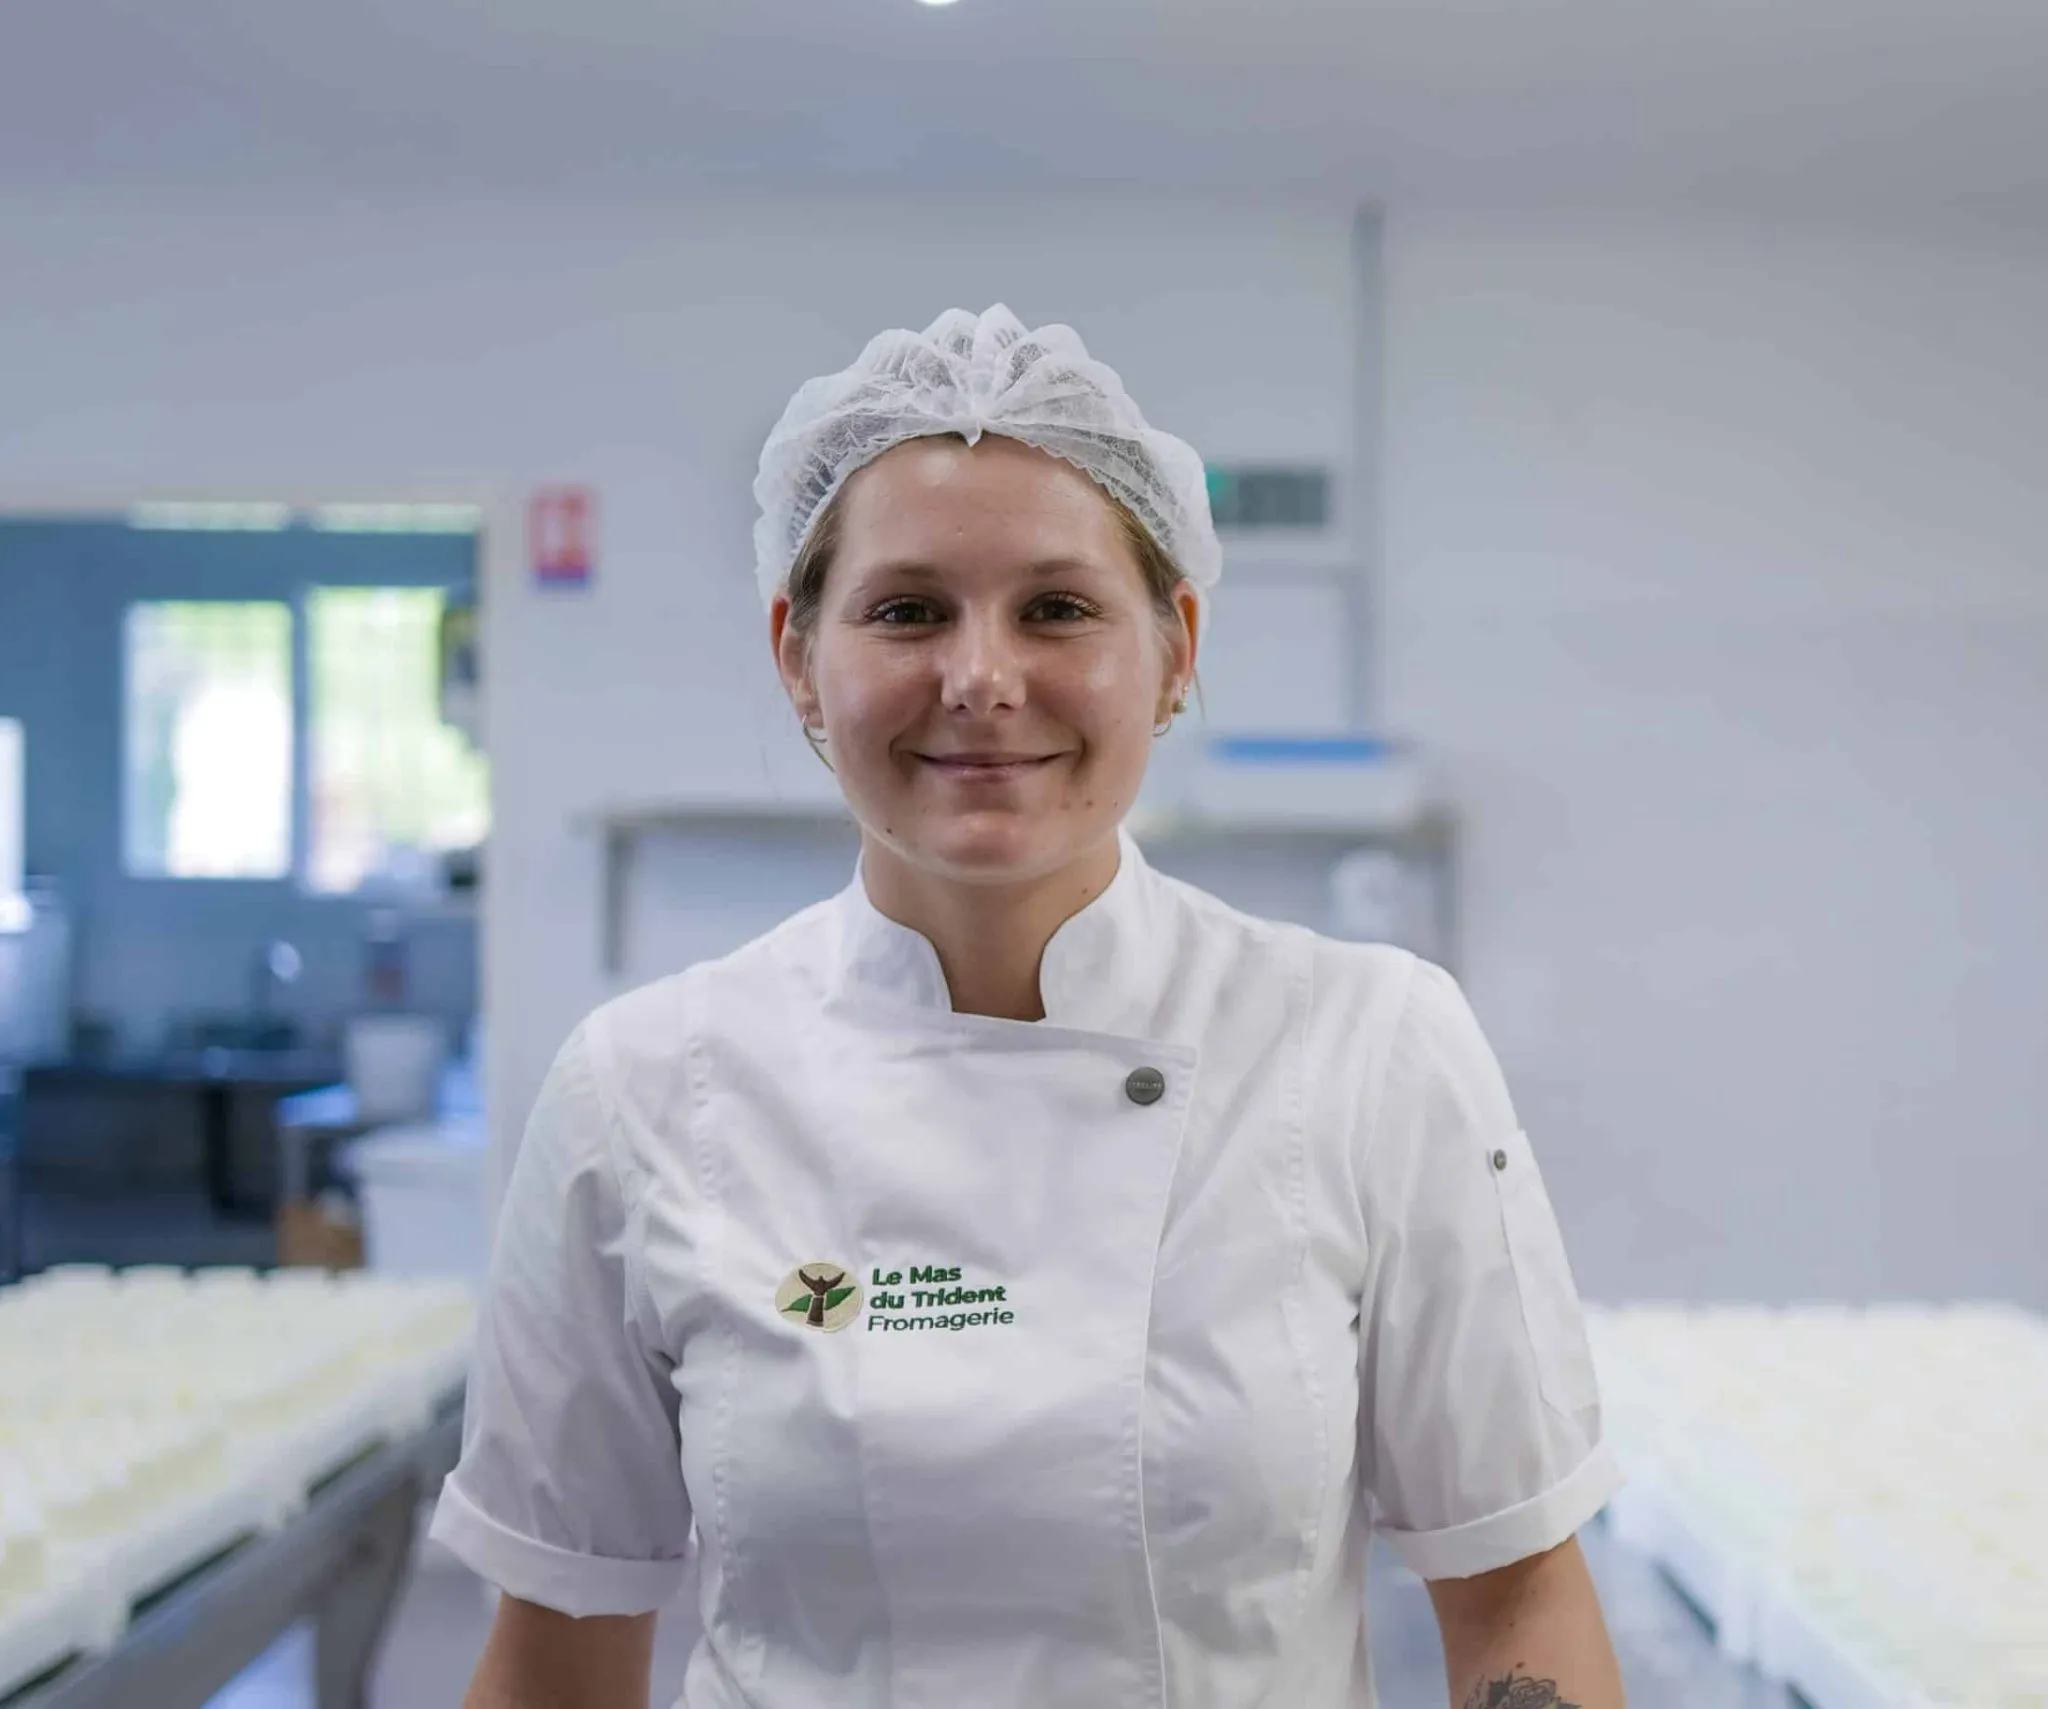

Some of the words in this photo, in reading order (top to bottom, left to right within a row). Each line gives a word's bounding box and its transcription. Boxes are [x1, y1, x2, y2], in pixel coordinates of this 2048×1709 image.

[872, 1268, 902, 1286] Le
[909, 1265, 962, 1284] Mas
[869, 1291, 905, 1309] du
[911, 1286, 1007, 1308] Trident
[868, 1308, 1014, 1331] Fromagerie
